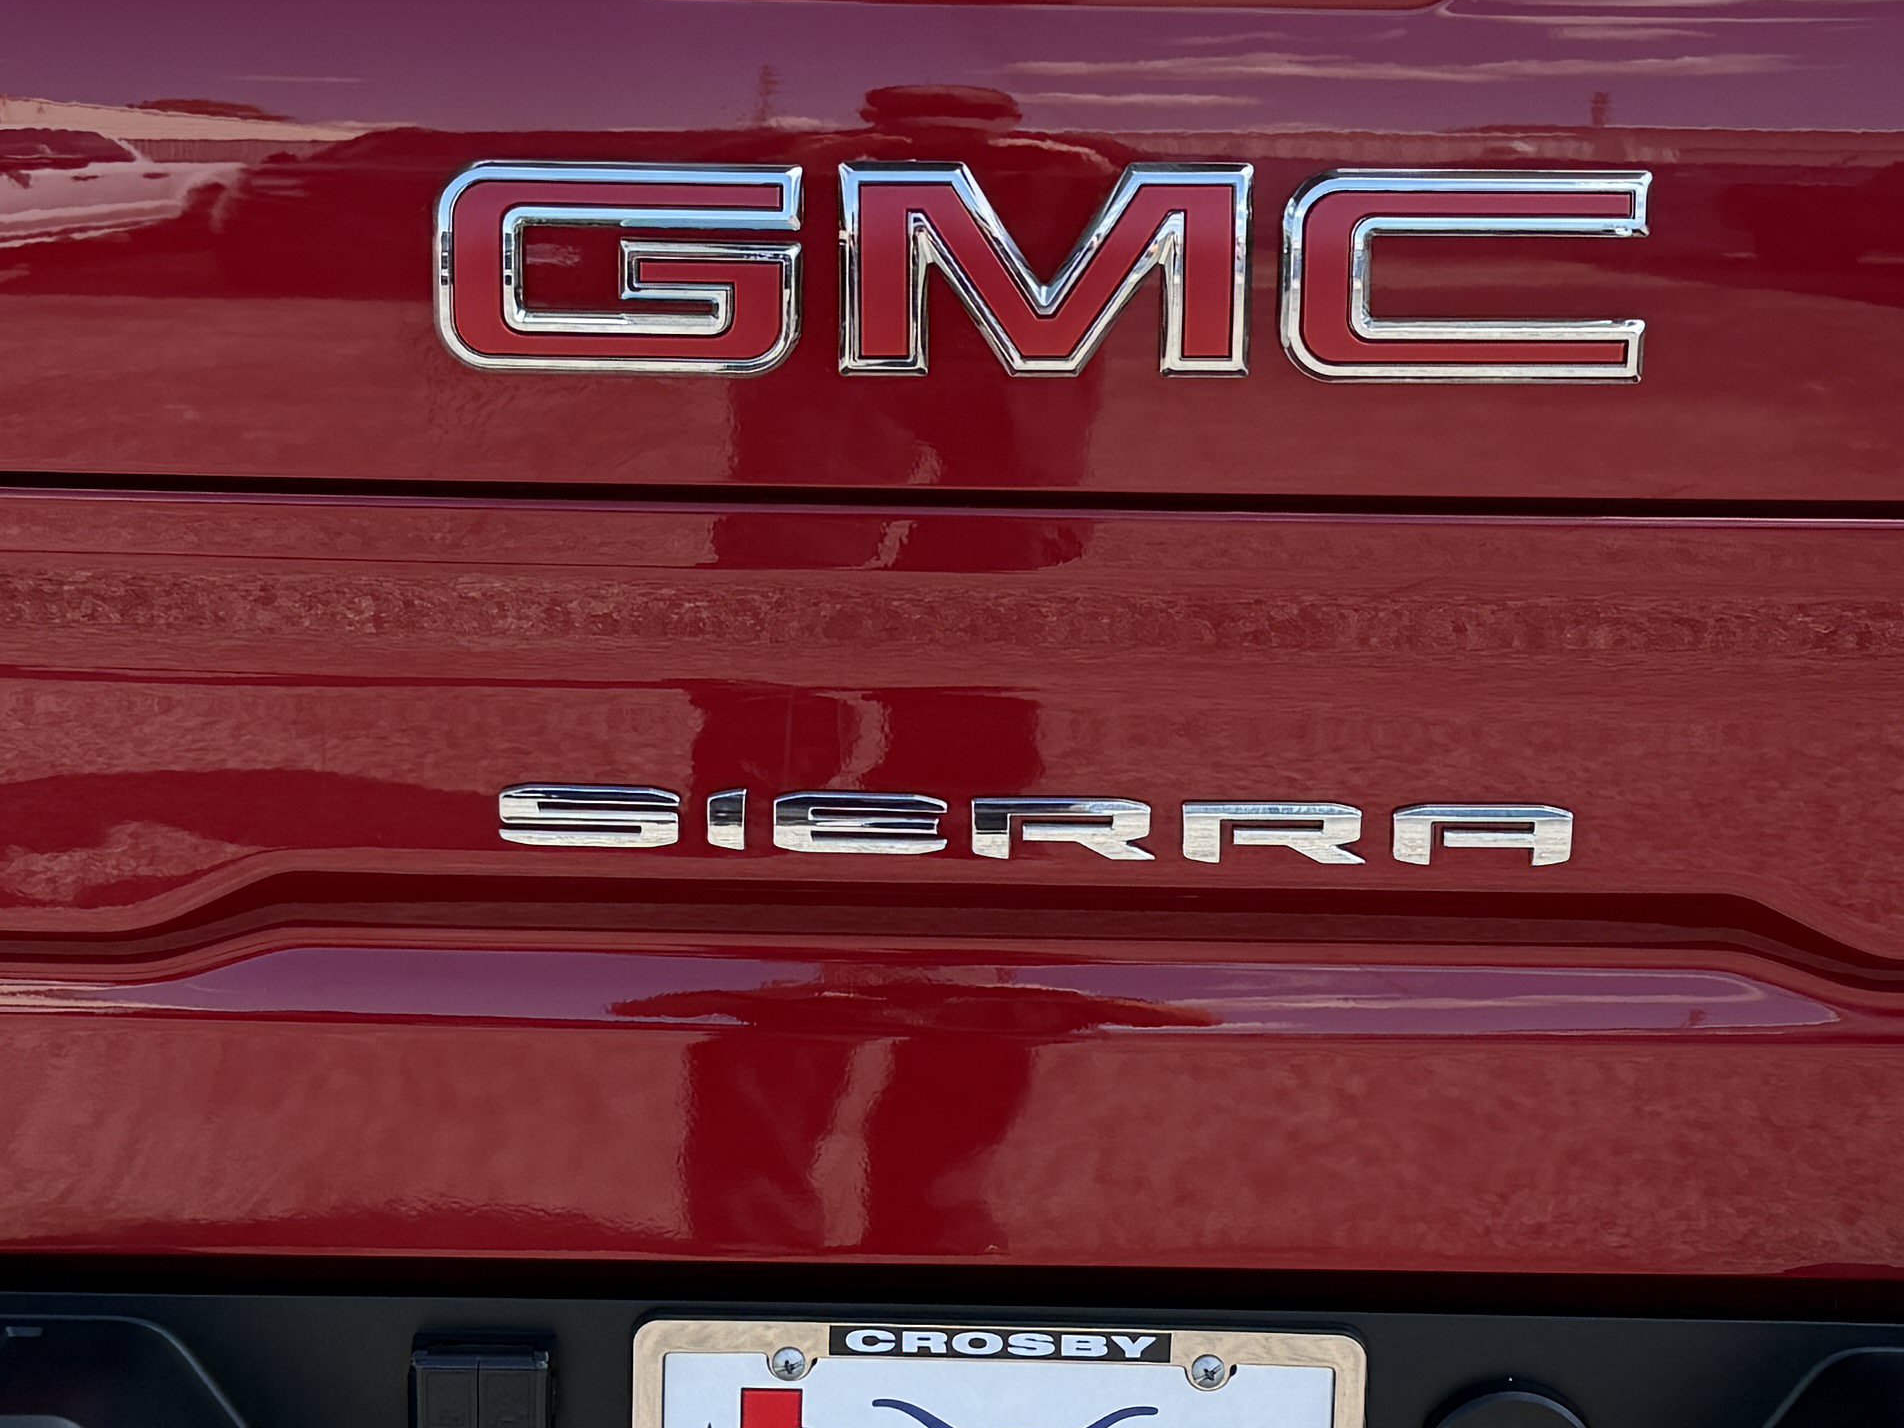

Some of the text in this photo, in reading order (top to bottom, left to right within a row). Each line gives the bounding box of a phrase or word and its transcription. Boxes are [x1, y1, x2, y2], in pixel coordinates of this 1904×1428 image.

[434, 162, 1653, 381] GMC
[497, 783, 1575, 865] SIERRA
[846, 1329, 1157, 1358] CROSBY
